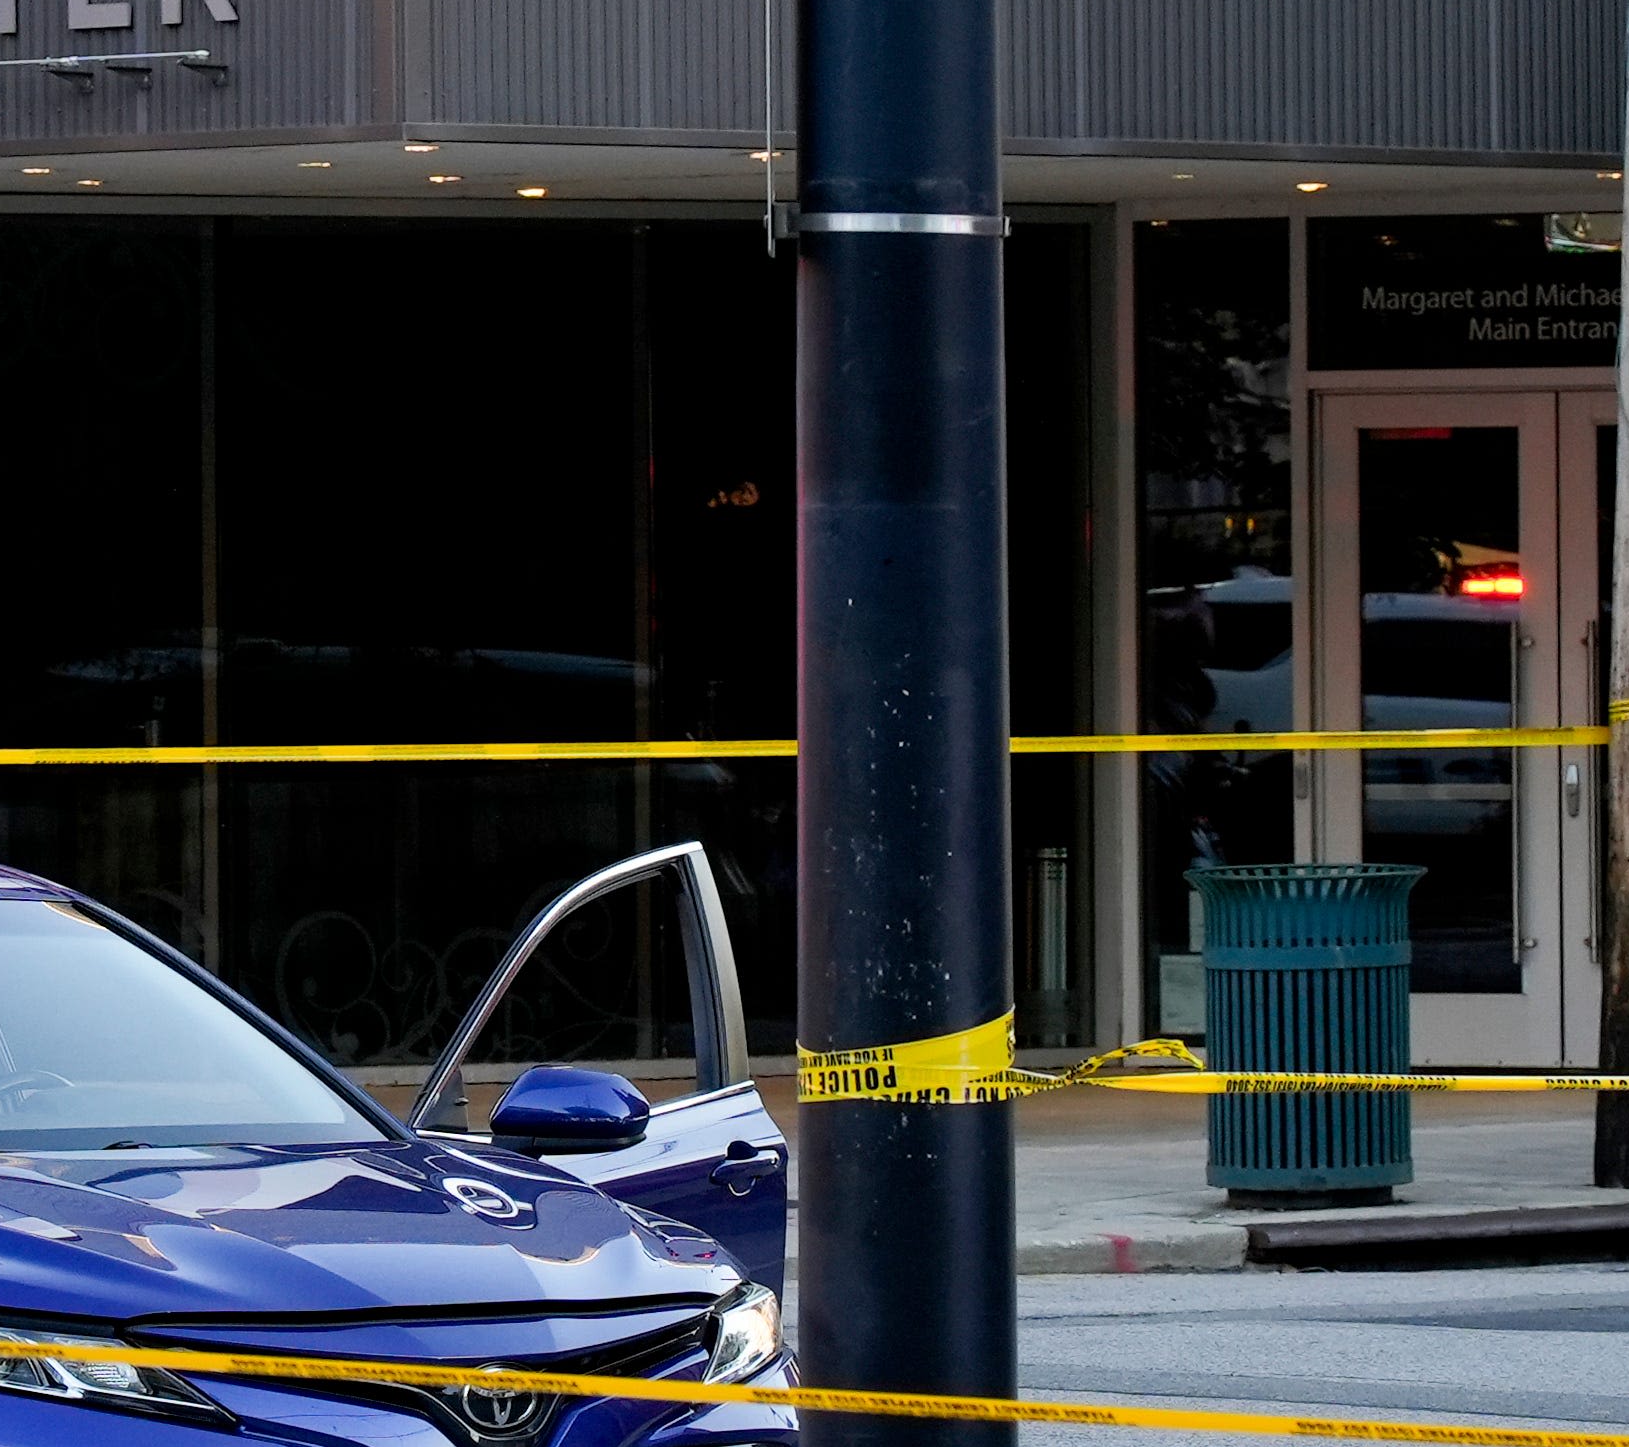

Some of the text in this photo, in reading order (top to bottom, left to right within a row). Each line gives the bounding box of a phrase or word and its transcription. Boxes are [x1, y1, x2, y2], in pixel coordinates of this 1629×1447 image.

[1362, 287, 1475, 316] Margaret
[1480, 284, 1528, 308] and
[1468, 319, 1531, 341] Main
[825, 1051, 850, 1066] HAVE
[854, 1051, 878, 1063] YOU
[882, 1049, 894, 1060] IF
[819, 1065, 896, 1094] POLICE
